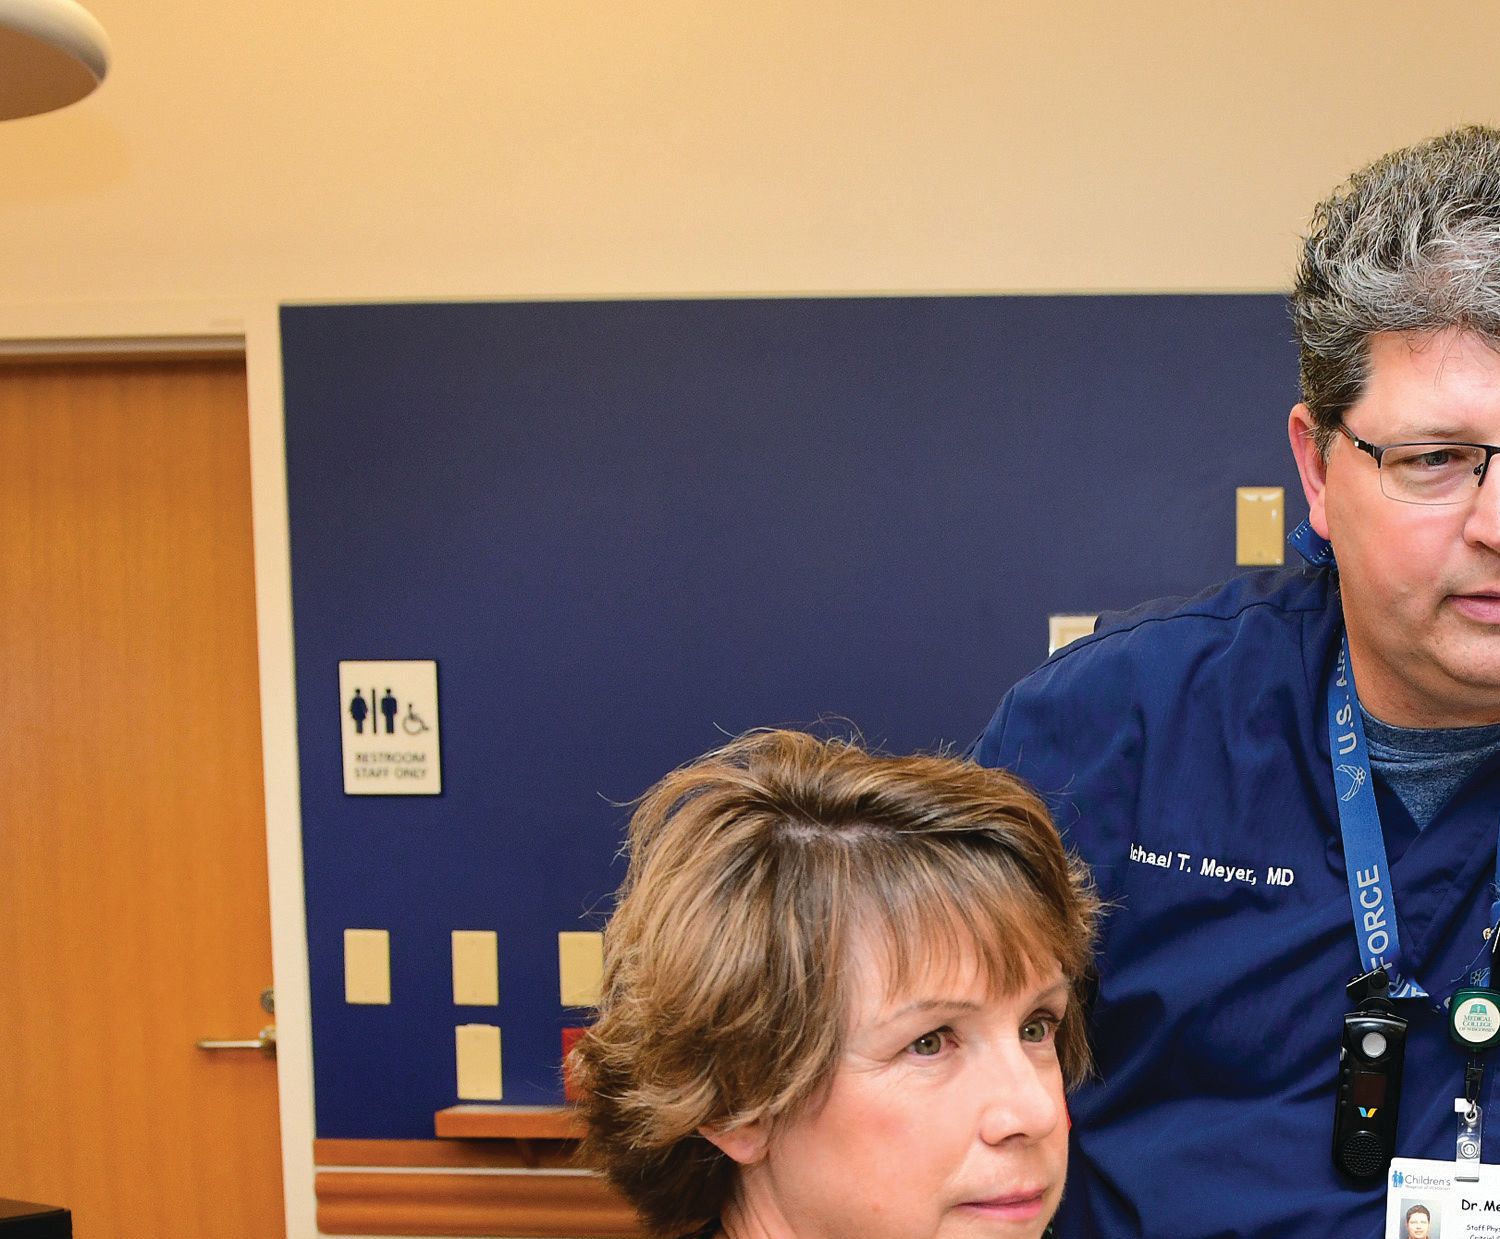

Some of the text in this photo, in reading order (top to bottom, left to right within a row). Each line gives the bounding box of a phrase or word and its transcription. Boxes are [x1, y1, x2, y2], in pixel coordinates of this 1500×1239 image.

[355, 752, 426, 763] RESTROOM
[354, 767, 427, 779] STAFF ONLY
[1129, 843, 1294, 887] ichael T. Meyer, MD
[1356, 864, 1393, 970] FORCE
[1405, 1174, 1451, 1186] Children's
[1467, 1224, 1485, 1232] Staff
